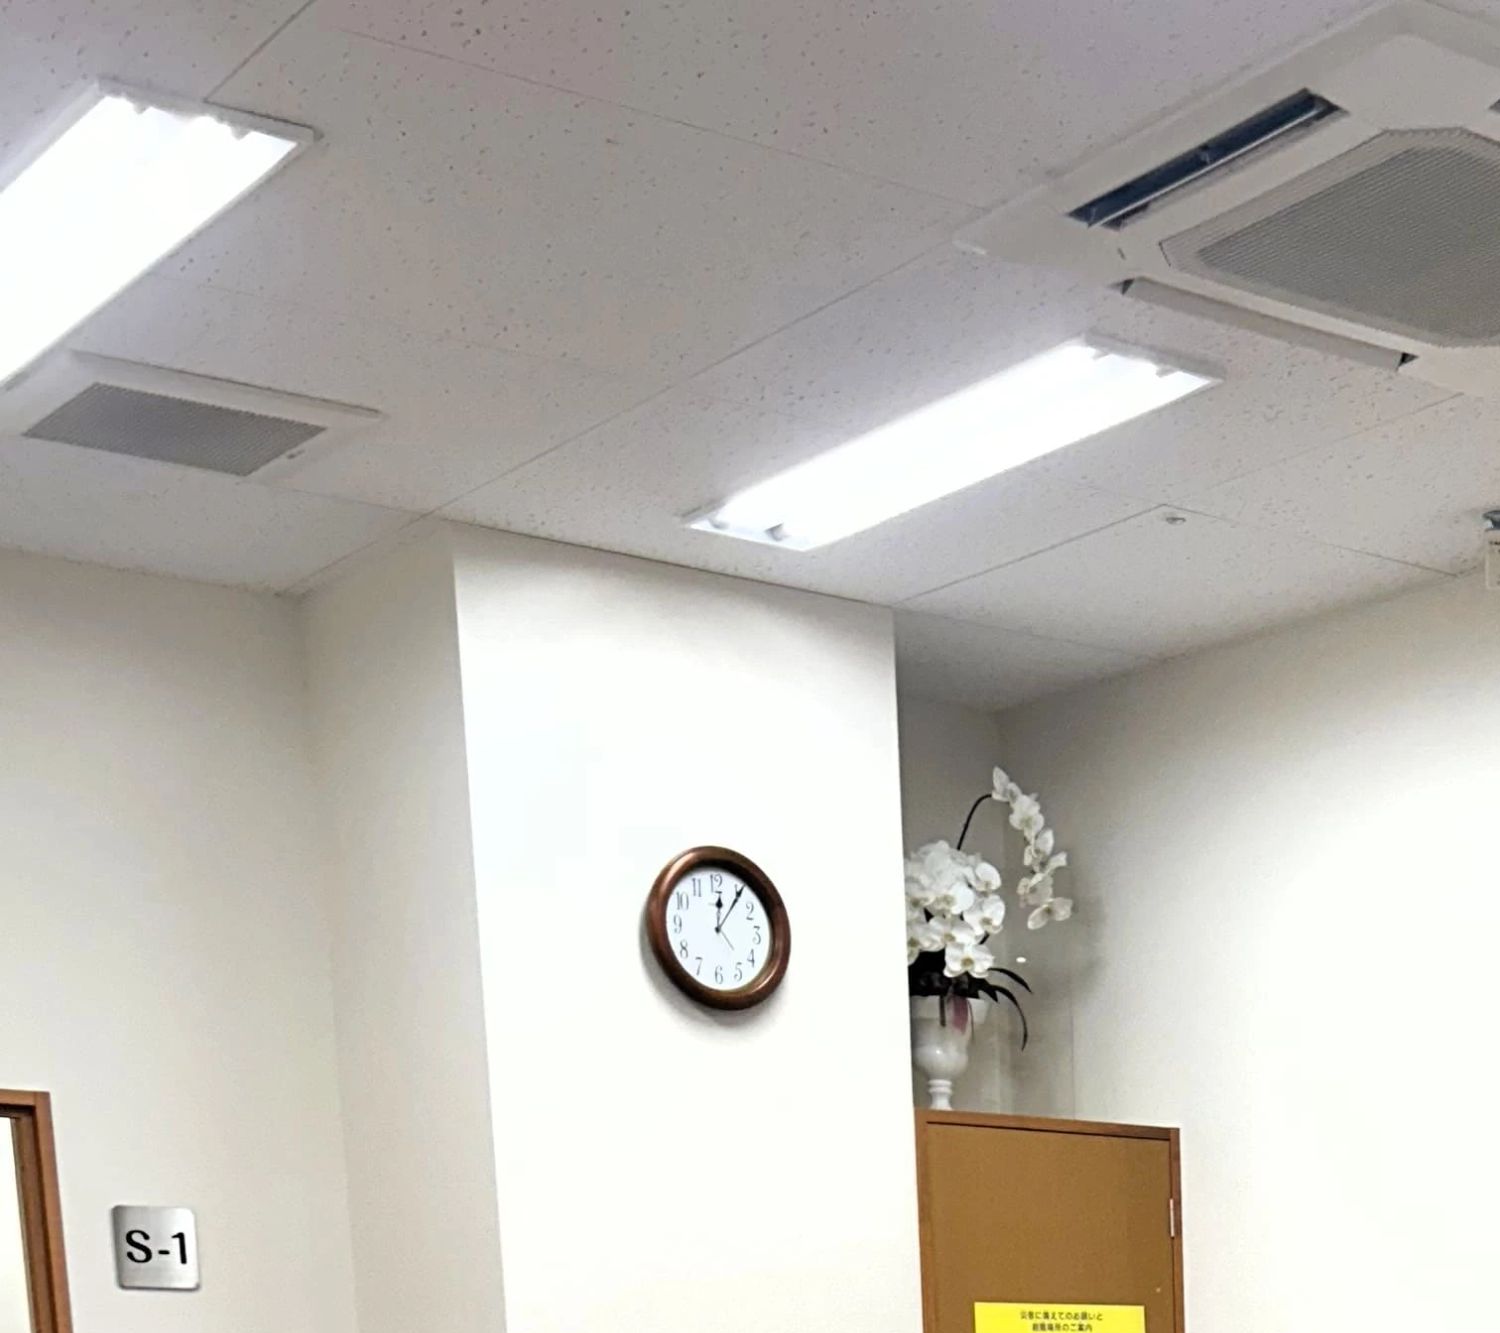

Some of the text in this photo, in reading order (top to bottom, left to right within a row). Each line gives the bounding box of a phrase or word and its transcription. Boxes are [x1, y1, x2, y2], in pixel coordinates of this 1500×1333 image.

[692, 877, 702, 897] 11
[710, 873, 723, 894] 12
[676, 891, 690, 911] 10
[746, 902, 754, 921] 2
[673, 914, 683, 934] 9
[753, 925, 761, 945] 3
[680, 939, 689, 959] 8
[747, 949, 755, 968] 4
[695, 957, 703, 976] 7
[714, 965, 724, 985] 6
[734, 962, 743, 982] 5
[125, 1229, 187, 1265] S-1
